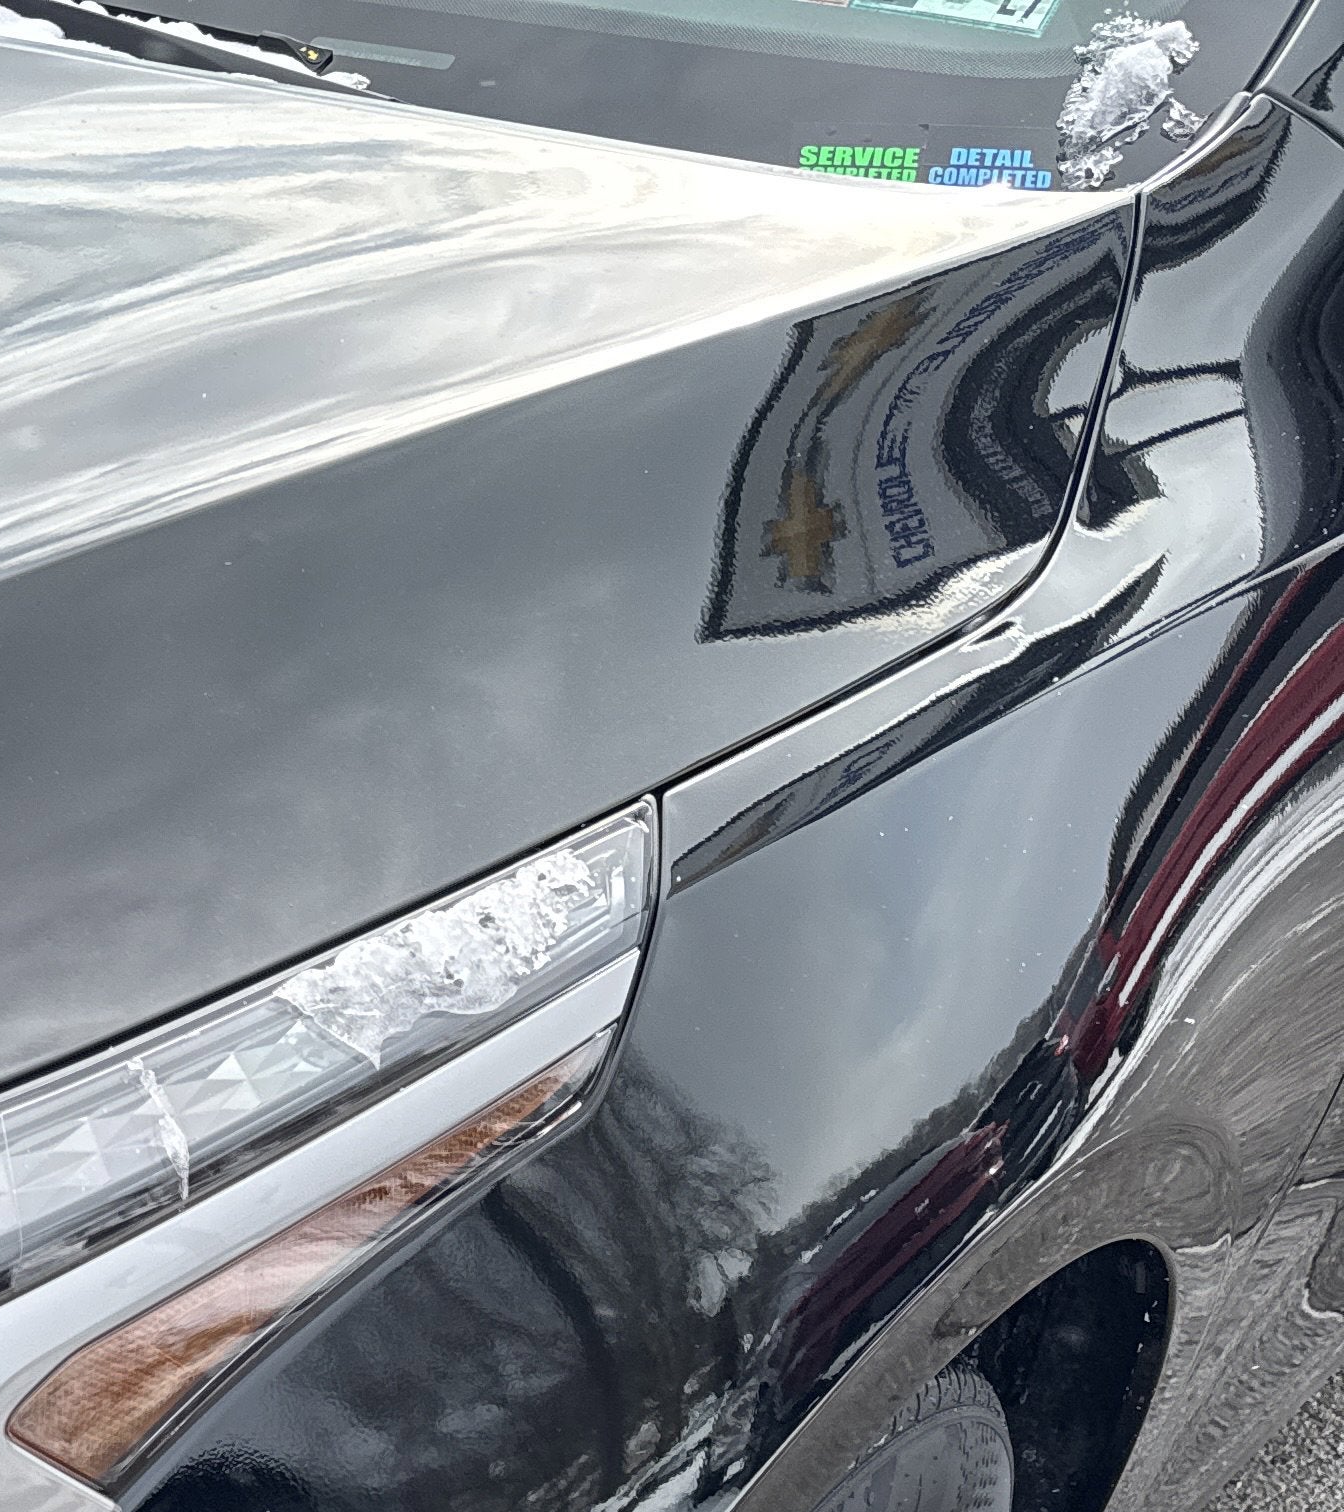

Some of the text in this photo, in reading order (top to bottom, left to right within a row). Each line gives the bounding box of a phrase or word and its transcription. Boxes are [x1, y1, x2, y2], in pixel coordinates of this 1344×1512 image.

[799, 146, 920, 167] SERVICE
[950, 148, 1033, 167] DETAIL
[800, 166, 917, 183] LETED
[928, 167, 1051, 188] COMPLETED
